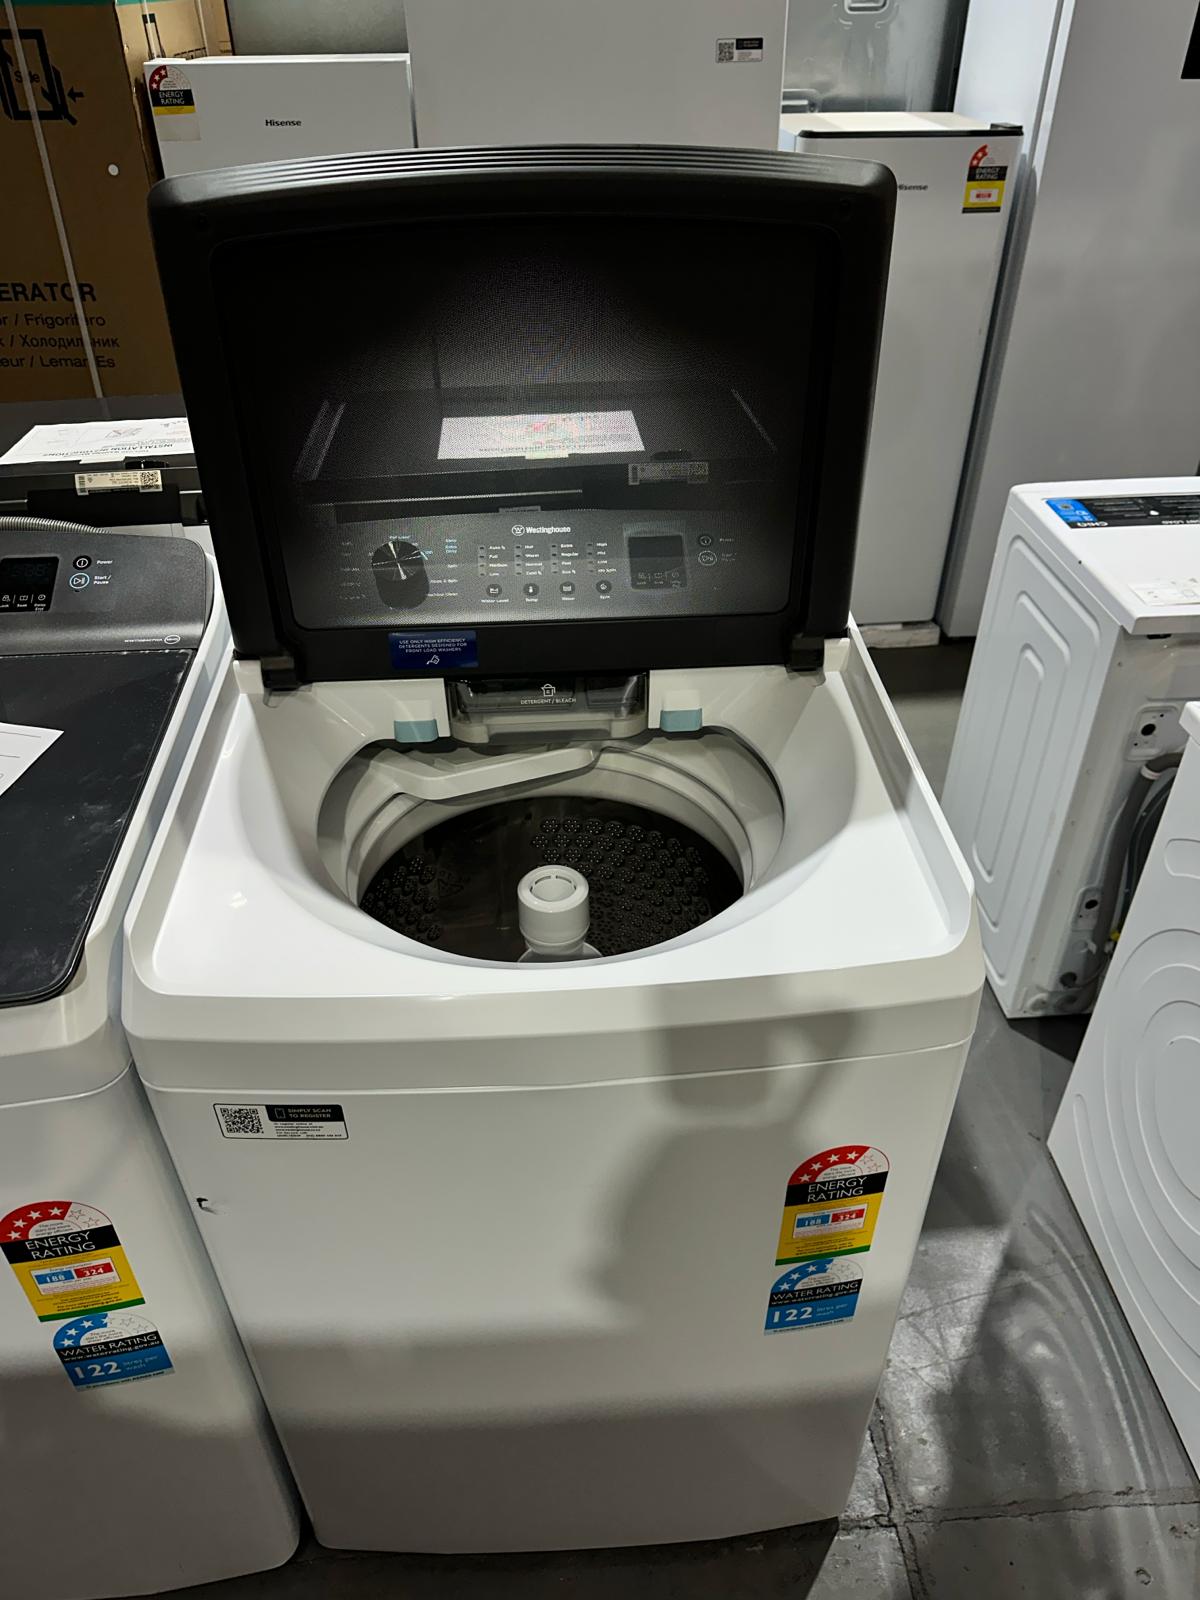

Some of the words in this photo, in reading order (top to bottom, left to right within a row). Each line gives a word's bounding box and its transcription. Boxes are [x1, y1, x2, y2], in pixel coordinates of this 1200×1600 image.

[24, 313, 106, 329] Frigorifro
[19, 334, 120, 350] Холодилник
[525, 526, 571, 534] Westinghouse
[808, 1176, 867, 1193] ENERGY
[807, 1187, 864, 1202] RATING
[25, 1231, 90, 1250] ENERGY
[31, 1242, 96, 1260] RATING
[84, 1267, 104, 1277] 324
[773, 1289, 813, 1300] WATER
[815, 1281, 858, 1295] RATING
[773, 1306, 813, 1323] 122
[61, 1344, 106, 1356] WATER
[109, 1334, 157, 1348] RATING
[74, 1362, 121, 1379] 122
